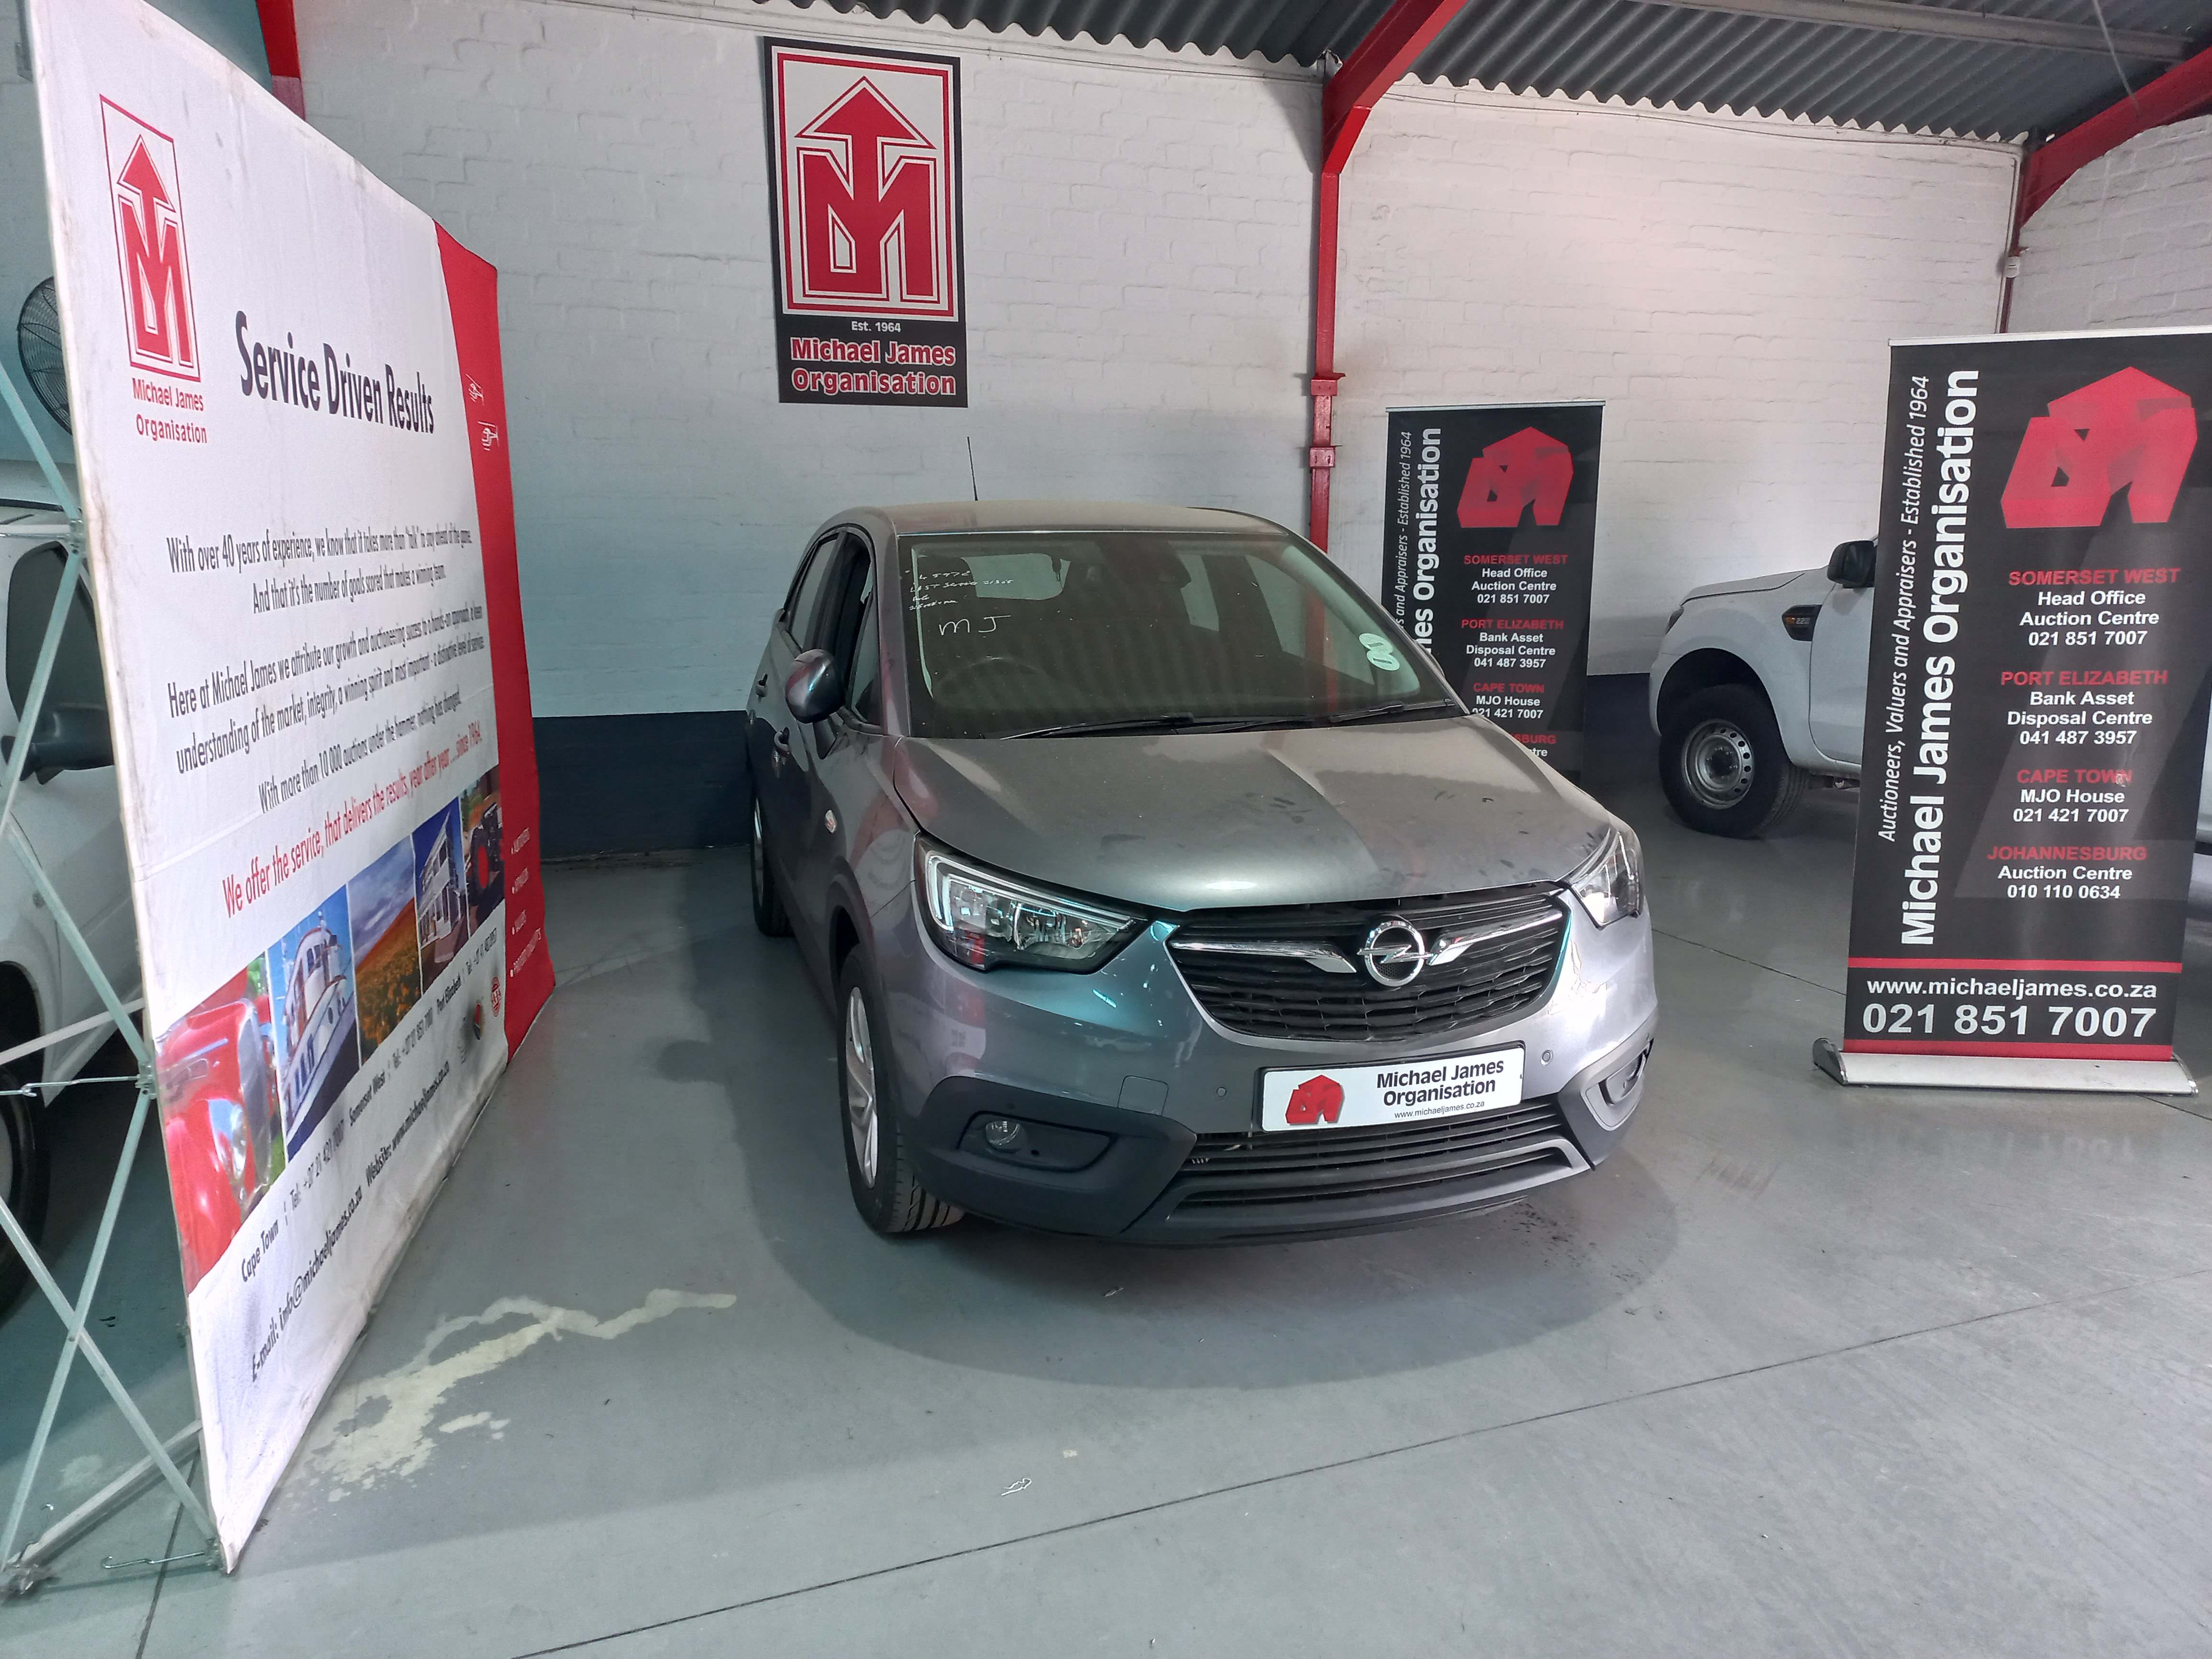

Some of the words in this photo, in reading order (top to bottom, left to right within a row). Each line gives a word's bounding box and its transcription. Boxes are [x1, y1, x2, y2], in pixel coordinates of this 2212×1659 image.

[852, 321, 871, 331] Est.
[875, 322, 901, 332] 1964
[790, 337, 881, 364] Michael
[885, 341, 956, 366] James
[236, 310, 321, 411] Service
[323, 343, 384, 424] Driven
[385, 364, 435, 434] Results
[792, 367, 956, 396] Organisation
[132, 377, 172, 407] Michael
[175, 387, 204, 411] James
[1909, 376, 1929, 419] 1964
[136, 413, 208, 443] Organisation
[1400, 431, 1412, 458] 1964
[1901, 425, 1926, 525] Established
[1397, 462, 1412, 525] Established
[1413, 427, 1441, 600] Organisation
[1923, 370, 1979, 643] Organisation
[166, 535, 195, 573] With
[198, 546, 219, 571] over
[222, 534, 234, 567] 40
[236, 541, 260, 574] years
[262, 529, 271, 562] of
[272, 531, 314, 568] experience,
[315, 538, 325, 557] we
[325, 528, 343, 556] know
[344, 527, 357, 555] that
[1464, 555, 1530, 565] SOMERSET
[1533, 554, 1568, 564] WEST
[1394, 534, 1409, 593] Appraisers
[1482, 567, 1511, 578] Head
[1514, 567, 1548, 578] Office
[1471, 581, 1515, 591] Auction
[1518, 581, 1557, 591] Centre
[1895, 539, 1917, 631] Appraisers
[2009, 570, 2117, 586] SOMERSET
[2124, 568, 2180, 584] WEST
[253, 579, 270, 614] And
[271, 577, 288, 609] that
[289, 577, 300, 607] it's
[301, 574, 313, 604] the
[314, 572, 339, 601] number
[341, 570, 348, 598] of
[349, 568, 365, 603] goals
[1477, 594, 1498, 604] 021
[1500, 594, 1520, 604] 851
[1523, 594, 1550, 604] 7007
[2037, 591, 2084, 606] Head
[2091, 590, 2146, 605] Office
[1394, 594, 1405, 616] and
[1461, 619, 1493, 630] PORT
[1496, 619, 1564, 630] ELIZABETH
[2019, 611, 2091, 626] Auction
[2098, 611, 2159, 625] Centre
[1480, 632, 1507, 642] Bank
[1510, 632, 1543, 642] Asset
[2028, 631, 2058, 646] 021
[2065, 631, 2097, 645] 851
[2104, 630, 2147, 645] 7007
[1466, 645, 1515, 657] Disposal
[1518, 645, 1556, 656] Centre
[1892, 633, 1909, 667] and
[167, 682, 197, 718] Here
[199, 679, 210, 709] at
[212, 660, 248, 705] Michael
[250, 660, 276, 692] James
[277, 658, 289, 680] we
[291, 642, 321, 676] attribute
[323, 646, 334, 666] our
[335, 631, 357, 669] growth
[358, 627, 369, 655] and
[1474, 658, 1493, 668] 041
[1496, 658, 1516, 668] 487
[1519, 658, 1547, 668] 3957
[1473, 683, 1505, 693] CAPE
[1508, 683, 1545, 694] TOWN
[2001, 671, 2054, 686] PORT
[2059, 670, 2168, 685] ELIZABETH
[1476, 696, 1501, 706] MJO
[1504, 696, 1540, 707] House
[1886, 675, 1908, 734] Valuers
[2030, 691, 2075, 706] Bank
[2081, 691, 2135, 706] Asset
[1494, 708, 1514, 718] 421
[1517, 709, 1544, 719] 7007
[1913, 655, 1956, 785] James
[2007, 711, 2086, 728] Disposal
[2092, 711, 2153, 725] Centre
[176, 718, 250, 774] understanding
[251, 707, 259, 742] of
[261, 704, 275, 737] the
[277, 694, 307, 725] market,
[2020, 730, 2049, 745] 041
[2056, 730, 2089, 744] 487
[2094, 730, 2137, 744] 3957
[258, 775, 280, 813] With
[281, 773, 301, 802] more
[301, 760, 319, 789] than
[319, 749, 329, 779] 10
[2017, 769, 2068, 784] CAPE
[2077, 769, 2132, 784] TOWN
[1878, 740, 1906, 842] Auctioneers,
[2020, 789, 2060, 803] MJO
[2066, 789, 2125, 803] House
[2013, 808, 2043, 822] 021
[2048, 808, 2079, 822] 421
[2087, 808, 2129, 822] 7007
[222, 874, 243, 918] We
[245, 856, 270, 904] offer
[273, 845, 289, 886] the
[291, 828, 324, 873] service,
[324, 811, 341, 847] that
[343, 796, 373, 834] delivers
[1987, 846, 2147, 861] JOHANNESBURG
[1901, 796, 1945, 945] Michael
[1998, 866, 2067, 880] Auction
[2073, 866, 2133, 880] Centre
[2007, 885, 2038, 898] 010
[2043, 885, 2073, 898] 110
[2078, 885, 2121, 899] 0634
[1867, 978, 2157, 1000] www.michaeljames.co.za
[1862, 1003, 1936, 1034] 021
[1954, 1005, 2028, 1035] 851
[2048, 1006, 2157, 1038] 7007
[1377, 1066, 1447, 1089] Michael
[1451, 1060, 1504, 1080] James
[1384, 1079, 1496, 1106] Organisation
[1394, 1101, 1485, 1118] www.michaeljames.co.za
[242, 1249, 260, 1283] Cape
[260, 1219, 278, 1255] Town
[252, 1317, 280, 1382] E-mail:
